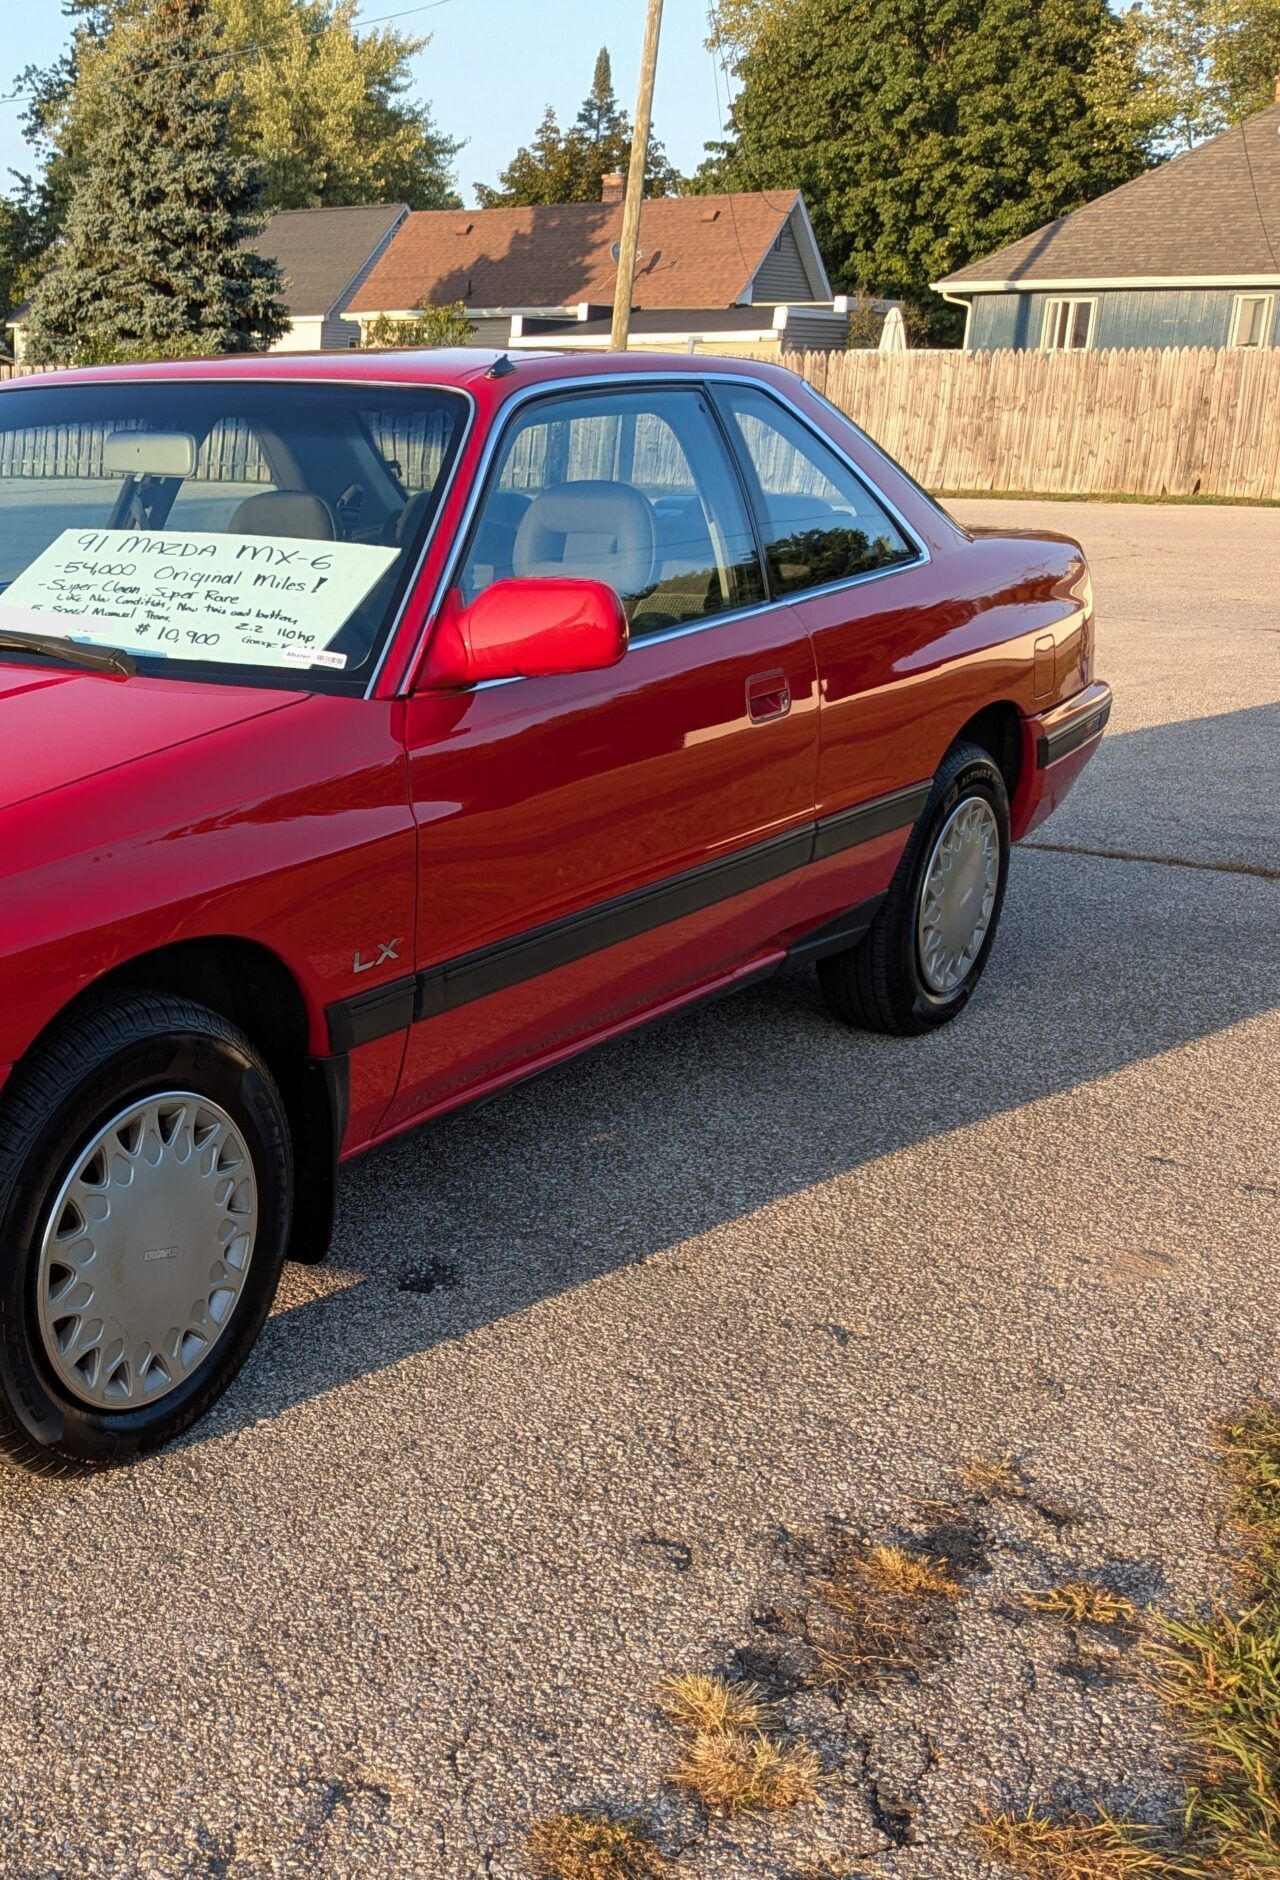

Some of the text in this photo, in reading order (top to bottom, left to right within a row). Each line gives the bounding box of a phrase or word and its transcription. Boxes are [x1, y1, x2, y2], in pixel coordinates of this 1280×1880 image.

[78, 532, 334, 570] 91 MAZDA MX-6
[154, 566, 242, 588] Original
[152, 587, 200, 601] Super
[204, 590, 239, 604] Rare
[235, 622, 264, 633] 2.2
[353, 937, 402, 973] LX
